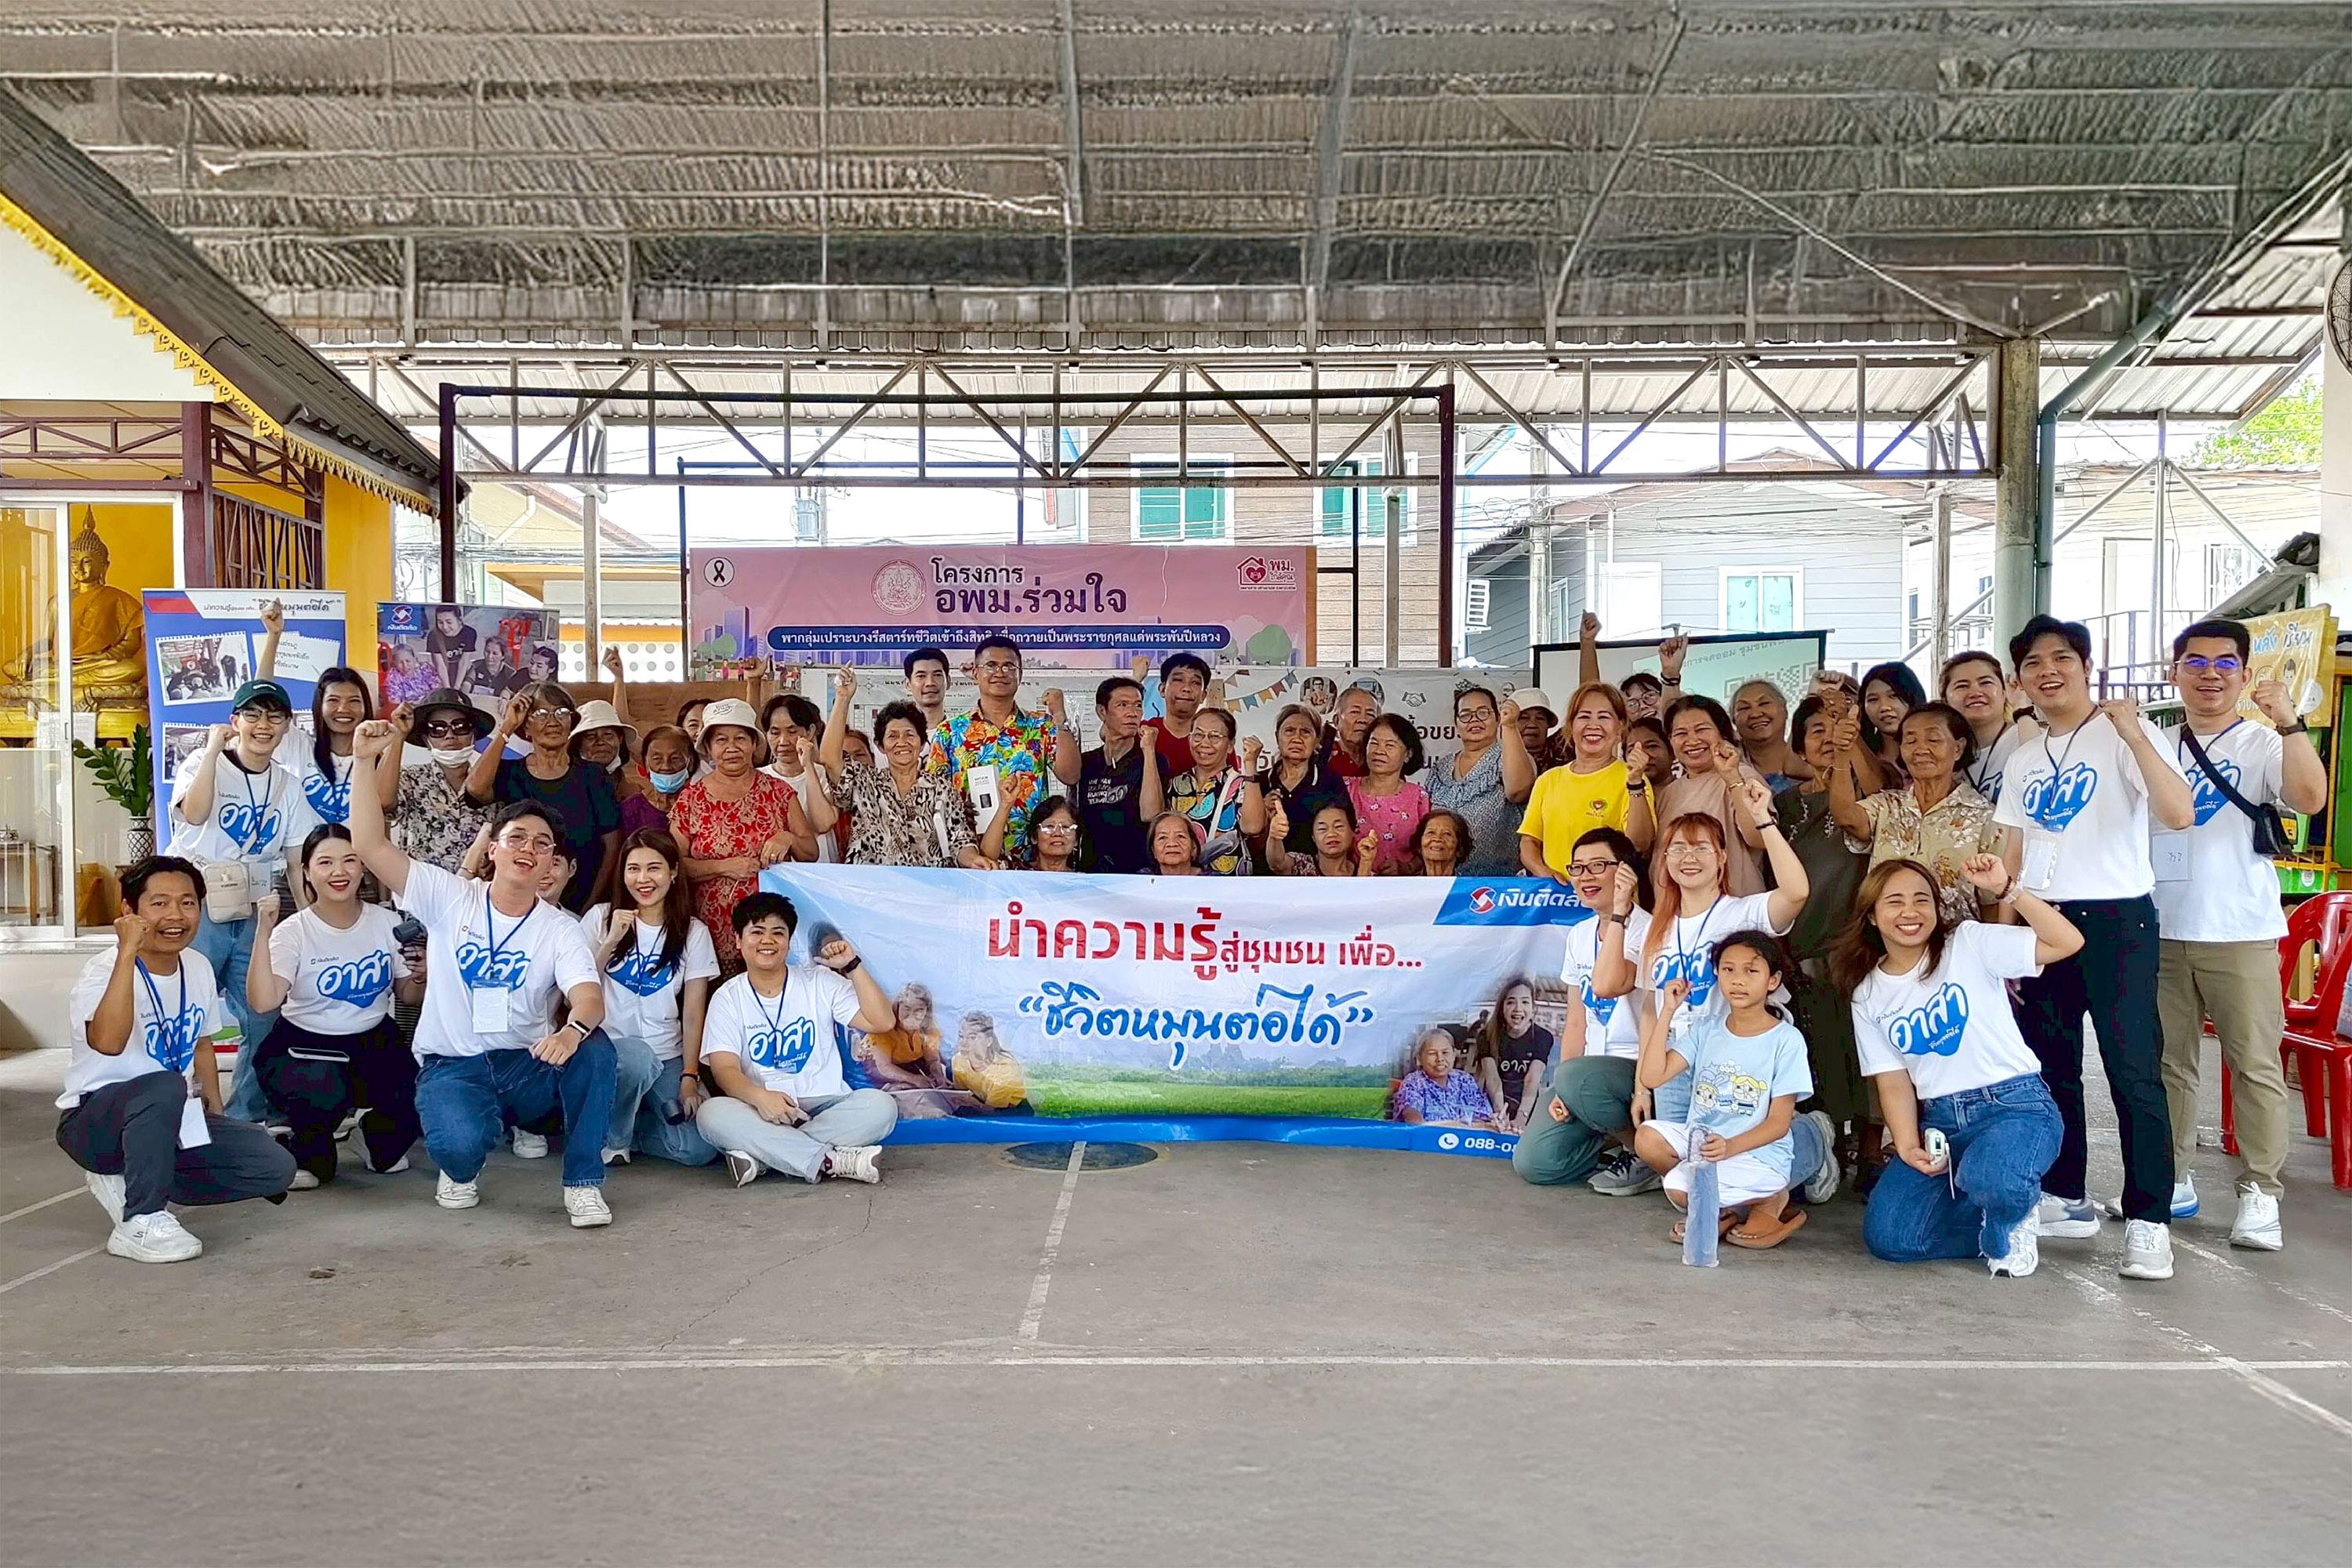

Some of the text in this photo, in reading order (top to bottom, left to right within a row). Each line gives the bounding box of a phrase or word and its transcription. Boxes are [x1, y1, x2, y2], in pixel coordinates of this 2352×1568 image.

[930, 557, 1023, 583] โครงการ
[1269, 560, 1294, 572] พม.
[935, 572, 1127, 614] อพม.ร่วมใจ
[2024, 763, 2096, 815] อาสา
[1497, 887, 1593, 908] เงินติดล
[454, 943, 531, 986] อาสา
[1339, 925, 1423, 968] เพื่อ...
[318, 950, 392, 996] อาสา
[750, 1018, 814, 1061] อาสา
[1018, 980, 1374, 1067] “ชีวิตหมุนต่อได้”
[1890, 983, 1967, 1054] อาสา
[1501, 1059, 1530, 1074] อาส
